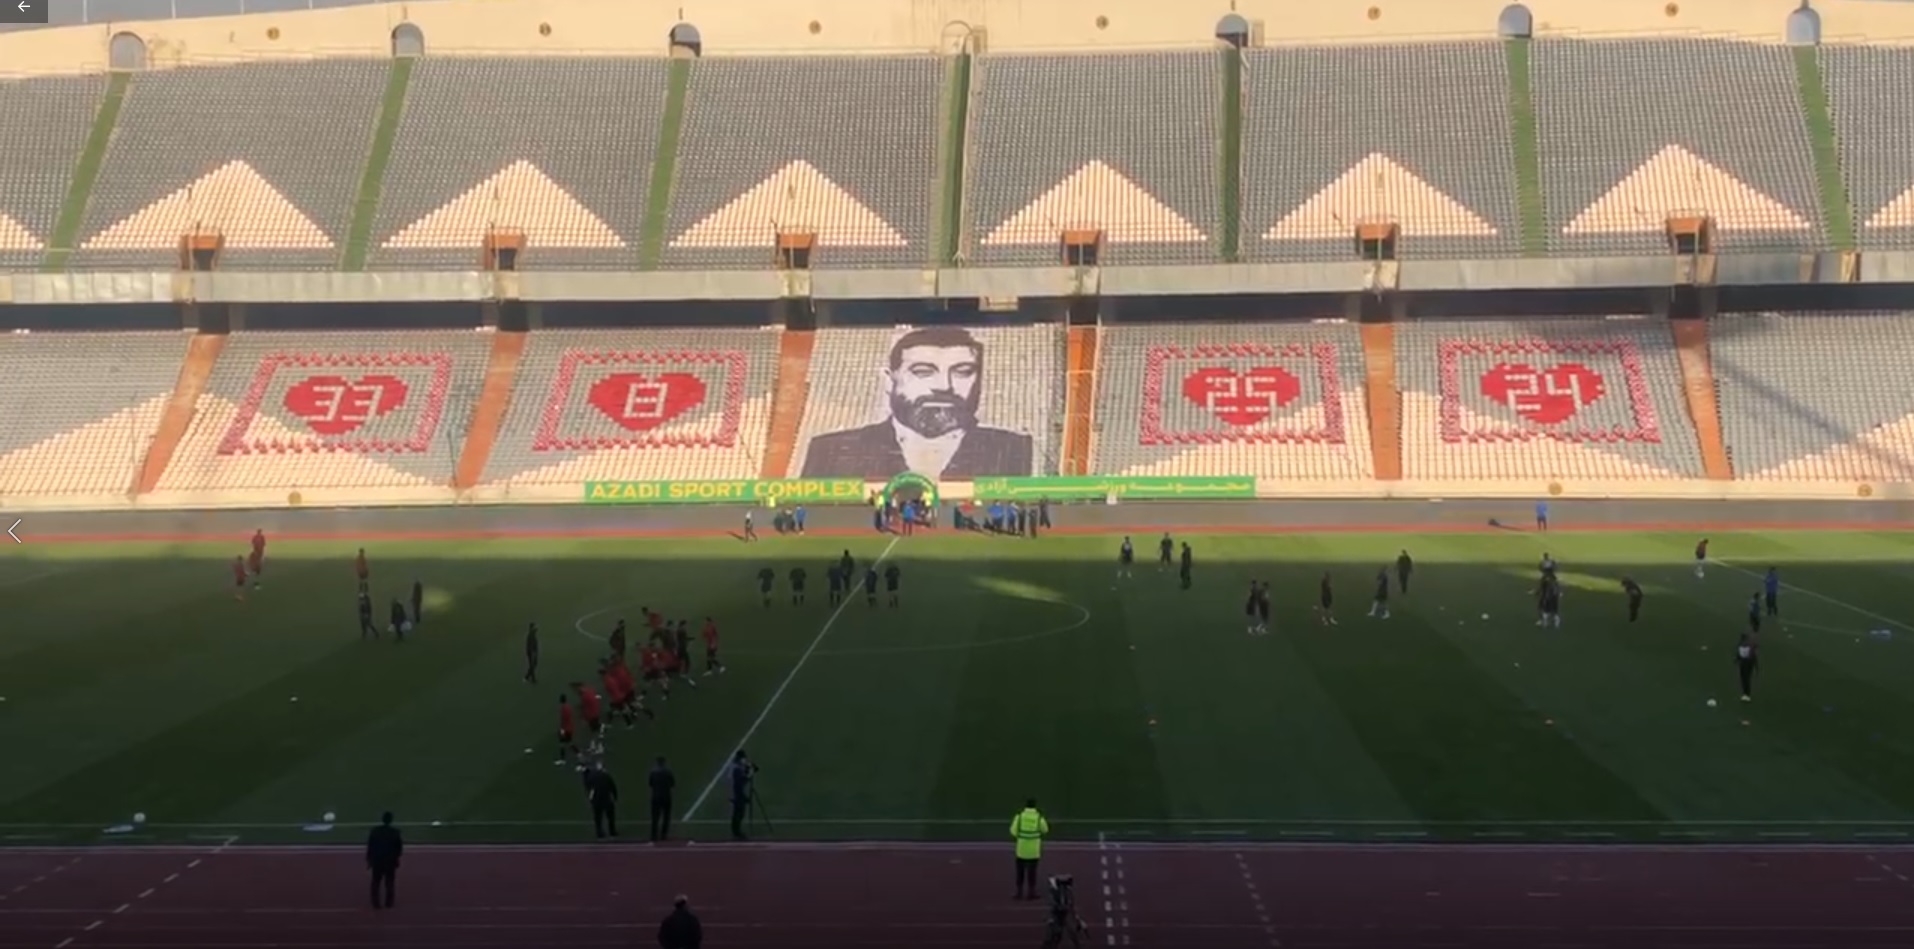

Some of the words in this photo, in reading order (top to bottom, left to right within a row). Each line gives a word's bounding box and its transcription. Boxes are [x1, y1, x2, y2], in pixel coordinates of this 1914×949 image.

[303, 385, 384, 421] 33
[622, 382, 669, 419] 8
[1204, 375, 1278, 413] 25
[1503, 372, 1583, 412] 24
[590, 482, 661, 498] AZADI
[669, 482, 747, 498] SPORT
[753, 480, 861, 498] COMPLEX
